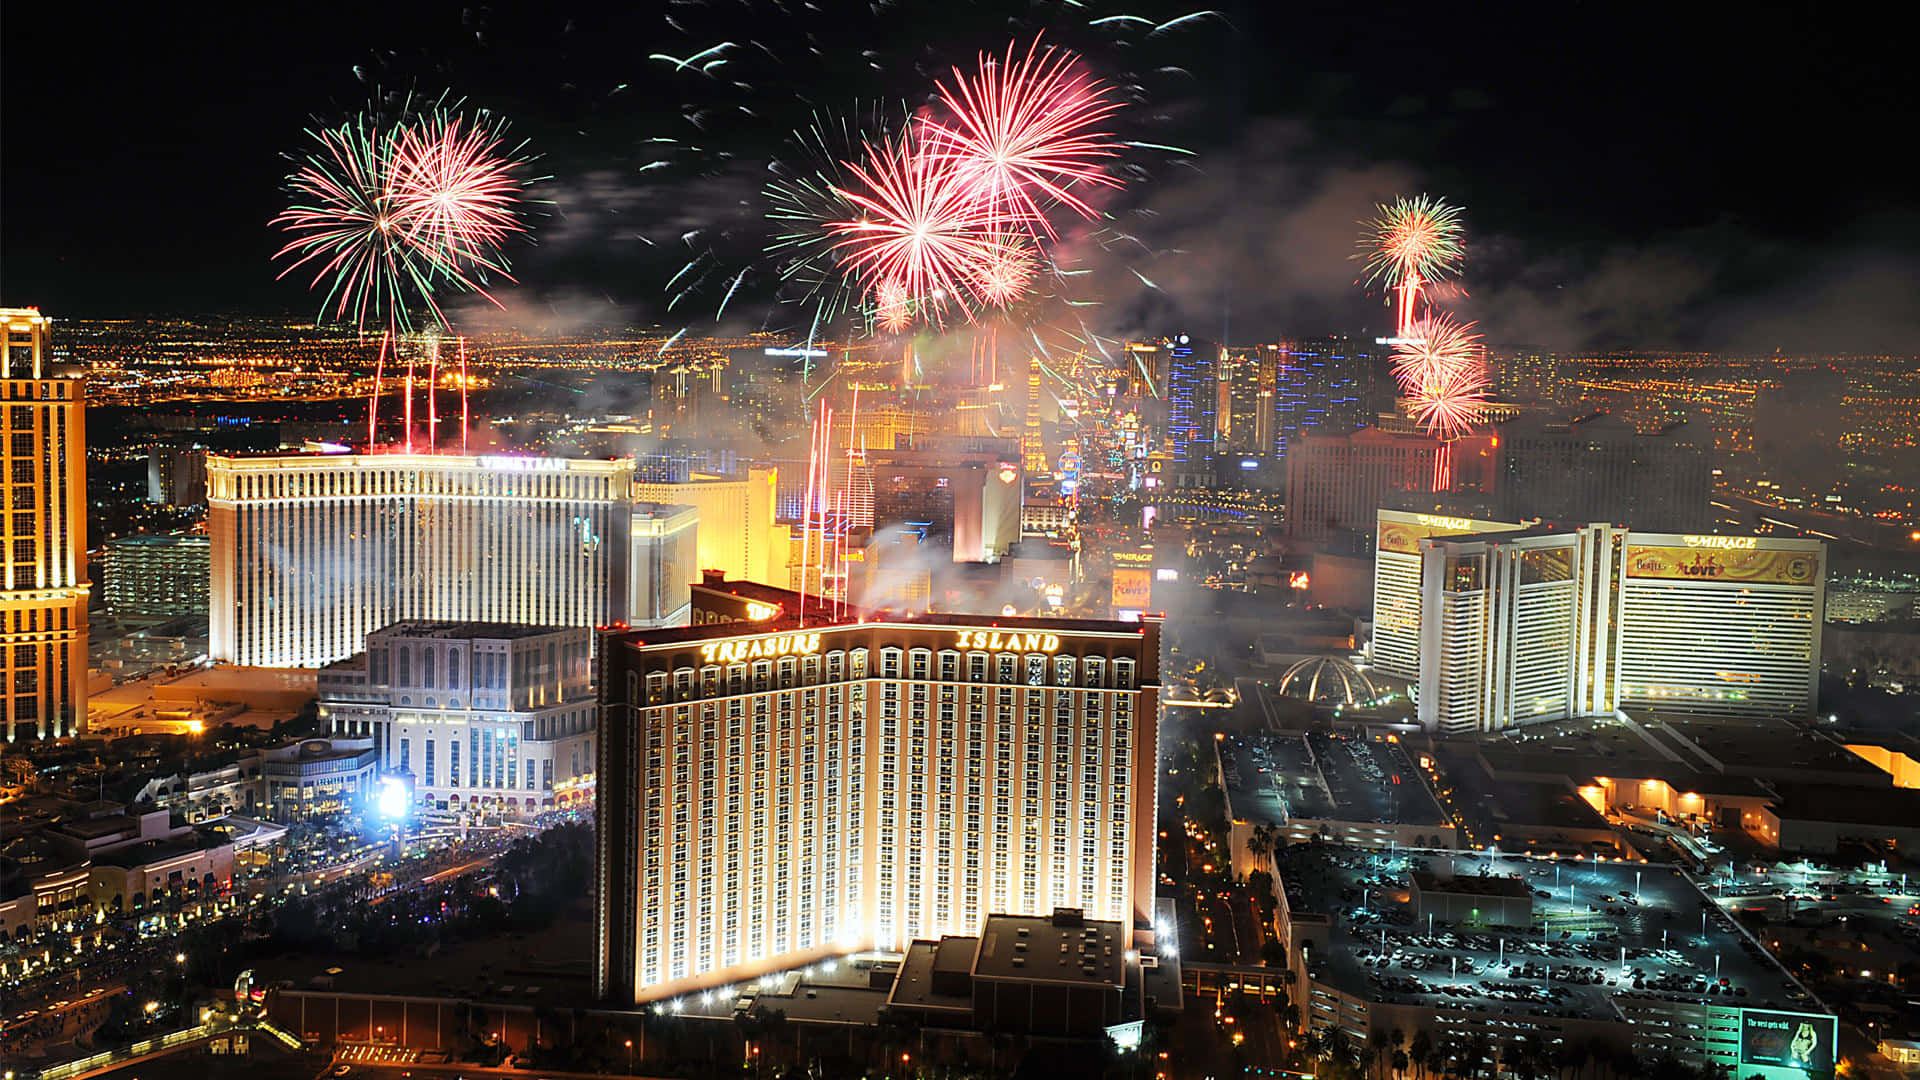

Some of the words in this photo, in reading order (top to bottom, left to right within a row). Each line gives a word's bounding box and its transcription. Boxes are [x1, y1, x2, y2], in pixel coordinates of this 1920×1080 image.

[1429, 515, 1471, 530] MIRAGE
[1697, 536, 1758, 549] MIRAGE
[1684, 565, 1716, 576] LOVE
[701, 634, 821, 662] TREASURE
[955, 630, 1060, 652] ISLAND
